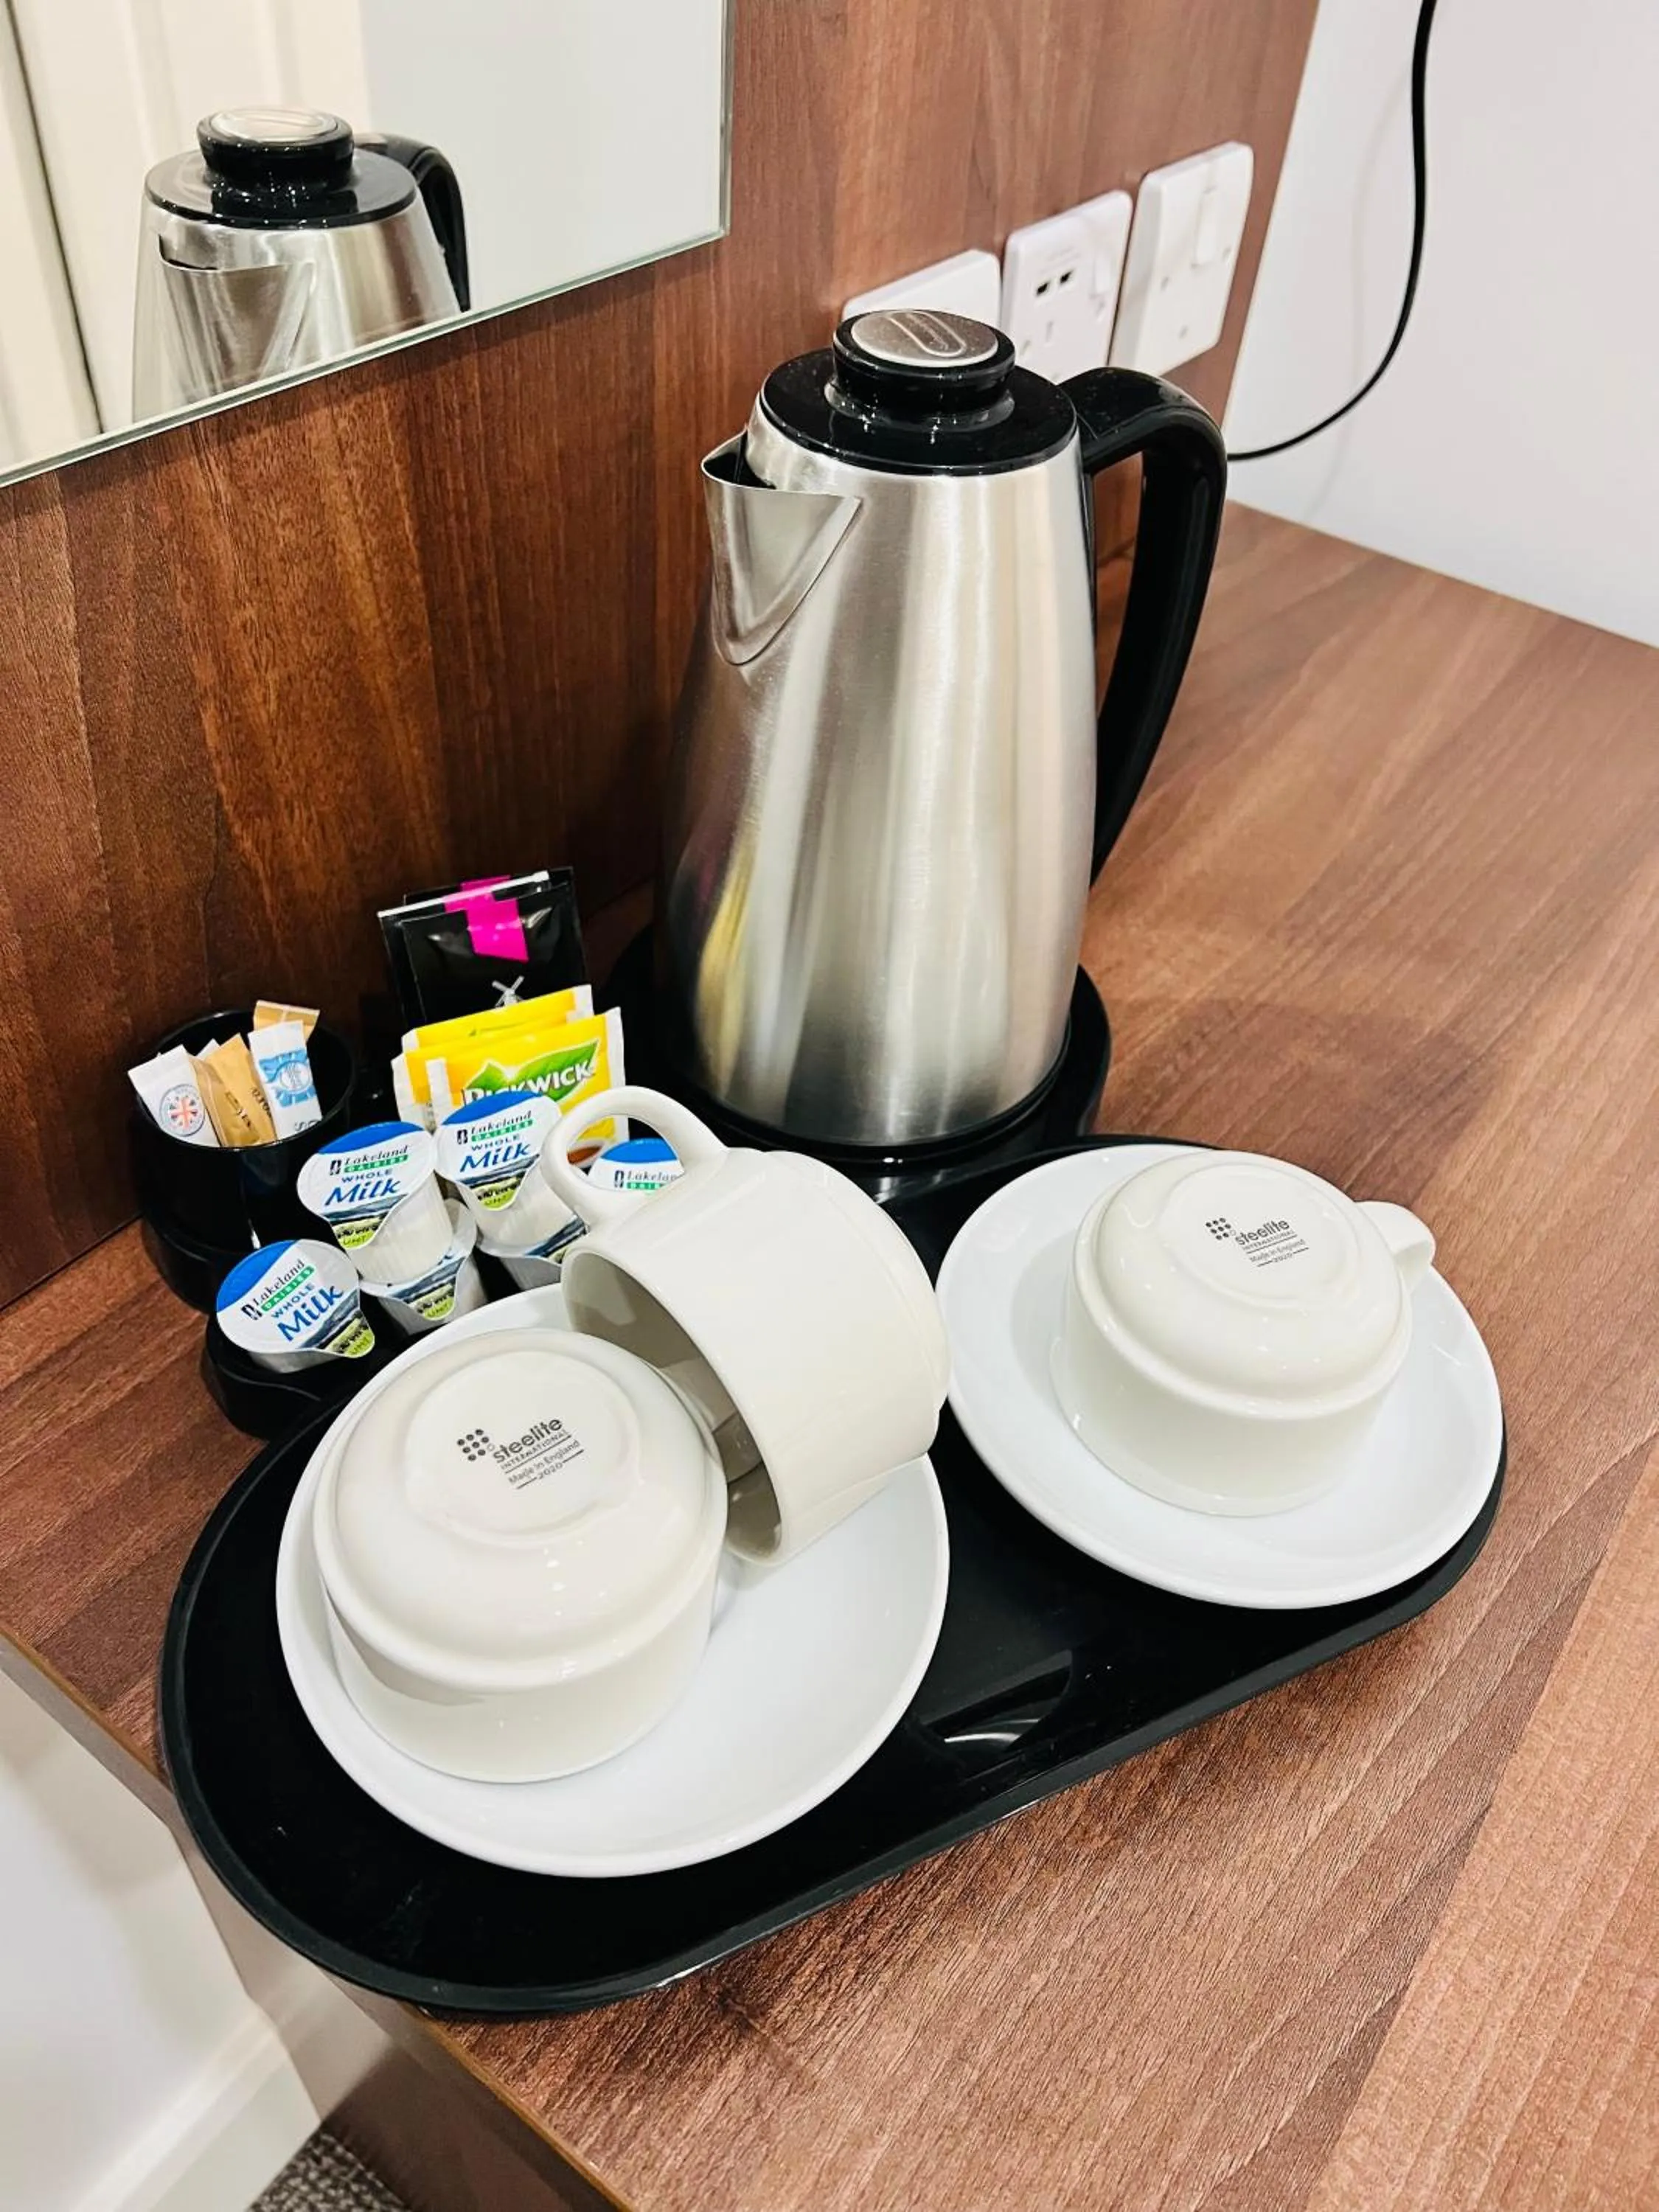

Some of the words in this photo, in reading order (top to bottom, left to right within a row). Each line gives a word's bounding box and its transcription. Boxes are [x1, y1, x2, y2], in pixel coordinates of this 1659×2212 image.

[463, 1060, 590, 1105] PWICK
[471, 1110, 532, 1134] Lakeland
[344, 1145, 408, 1165] Lakeland
[459, 1142, 531, 1172] Milk
[471, 1133, 520, 1152] WHOLE
[341, 1168, 392, 1183] WHOLE
[627, 1171, 678, 1181] Lakelan
[324, 1178, 400, 1206] Milk
[1236, 1220, 1290, 1245] steelite
[253, 1259, 305, 1306] Lakeland
[262, 1266, 315, 1311] DAIRIES
[271, 1282, 315, 1318] WHOLE
[277, 1285, 344, 1342] Milk
[493, 1419, 562, 1464] steelite
